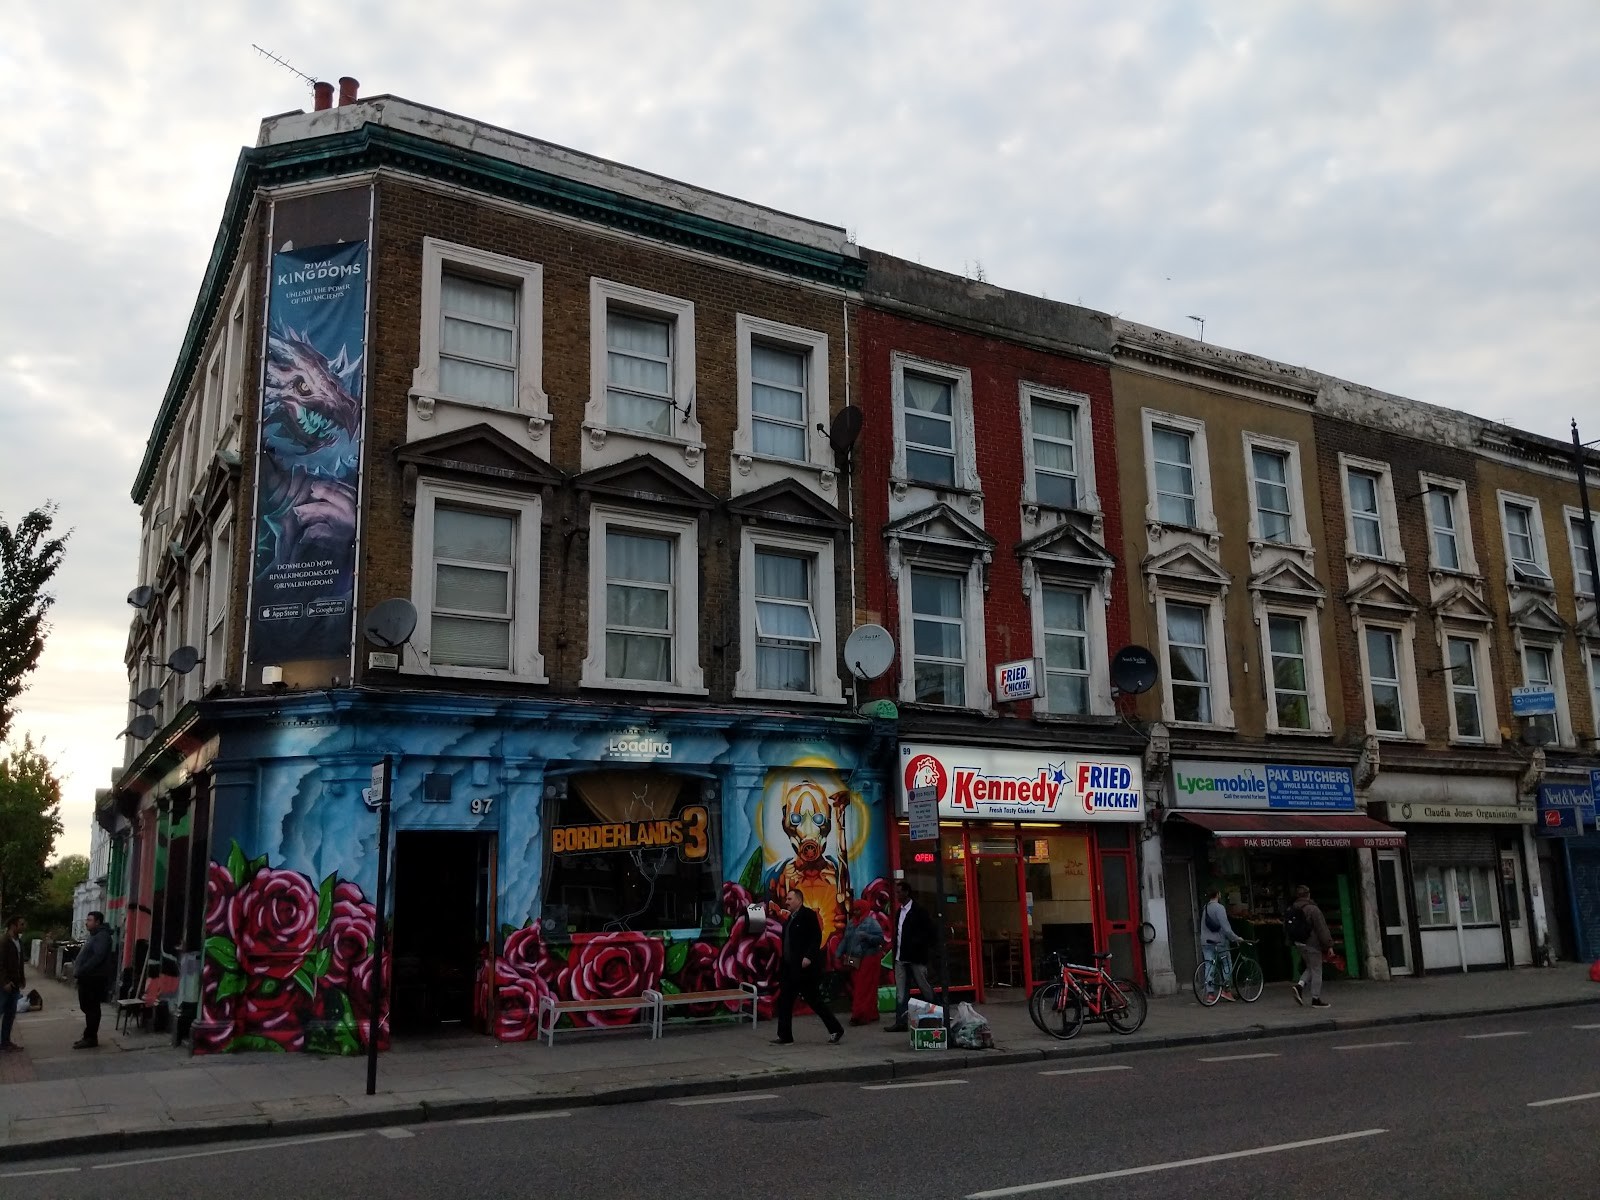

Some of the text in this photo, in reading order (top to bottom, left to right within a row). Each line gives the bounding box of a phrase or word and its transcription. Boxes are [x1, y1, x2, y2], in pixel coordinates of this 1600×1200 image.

[304, 260, 333, 270] RIVAL
[278, 263, 361, 286] KINGDOMS
[286, 288, 312, 298] UNLEASH
[327, 284, 350, 292] POWER
[312, 291, 344, 302] ANCIENTS
[277, 560, 334, 570] DOWNLOAD NOW
[269, 568, 340, 580] RIVALKINGDOMS.COM
[274, 578, 334, 590] @RIVALKINGDOMS
[315, 606, 334, 614] Google
[1001, 667, 1026, 686] FRIED
[1004, 680, 1030, 694] CHICKEN
[610, 738, 672, 758] Loading
[1078, 765, 1131, 793] FRIED
[1177, 772, 1266, 794] Lycamobile
[1267, 768, 1349, 784] PAK BUTCHERS
[954, 771, 1059, 810] Kennedy
[471, 798, 493, 814] 97
[1085, 792, 1138, 811] CHICKEN
[1004, 806, 1016, 814] Tasty
[1424, 808, 1450, 817] Claudia
[1454, 808, 1473, 818] Jones
[1476, 809, 1517, 820] Organisation
[552, 806, 708, 858] BORDERLANDS 3
[1244, 839, 1258, 847] PAK
[1260, 839, 1292, 847] BUTCHER
[914, 854, 934, 862] OPEN
